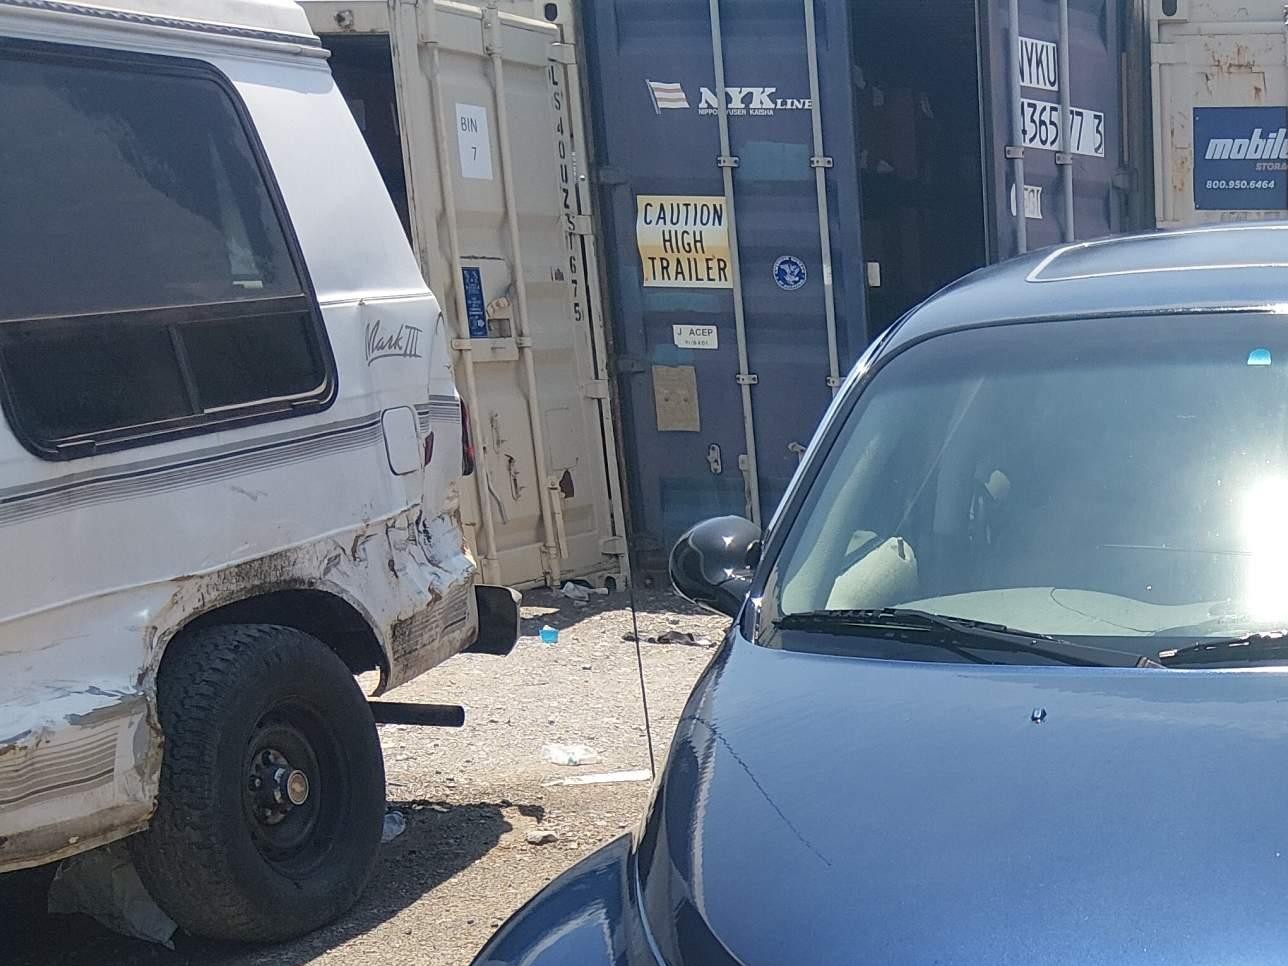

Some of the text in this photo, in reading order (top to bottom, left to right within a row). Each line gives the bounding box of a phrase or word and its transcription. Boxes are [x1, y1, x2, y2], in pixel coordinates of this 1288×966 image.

[699, 87, 812, 109] NYK LINE
[460, 116, 478, 133] BIN
[1093, 114, 1103, 153] 3
[471, 146, 477, 161] 7
[1206, 179, 1275, 189] 800.950.6464
[643, 202, 723, 227] CAUTION
[662, 229, 705, 254] HIGH
[647, 256, 728, 282] TRAILER
[365, 319, 423, 361] Mark III
[688, 328, 714, 337] ACEP
